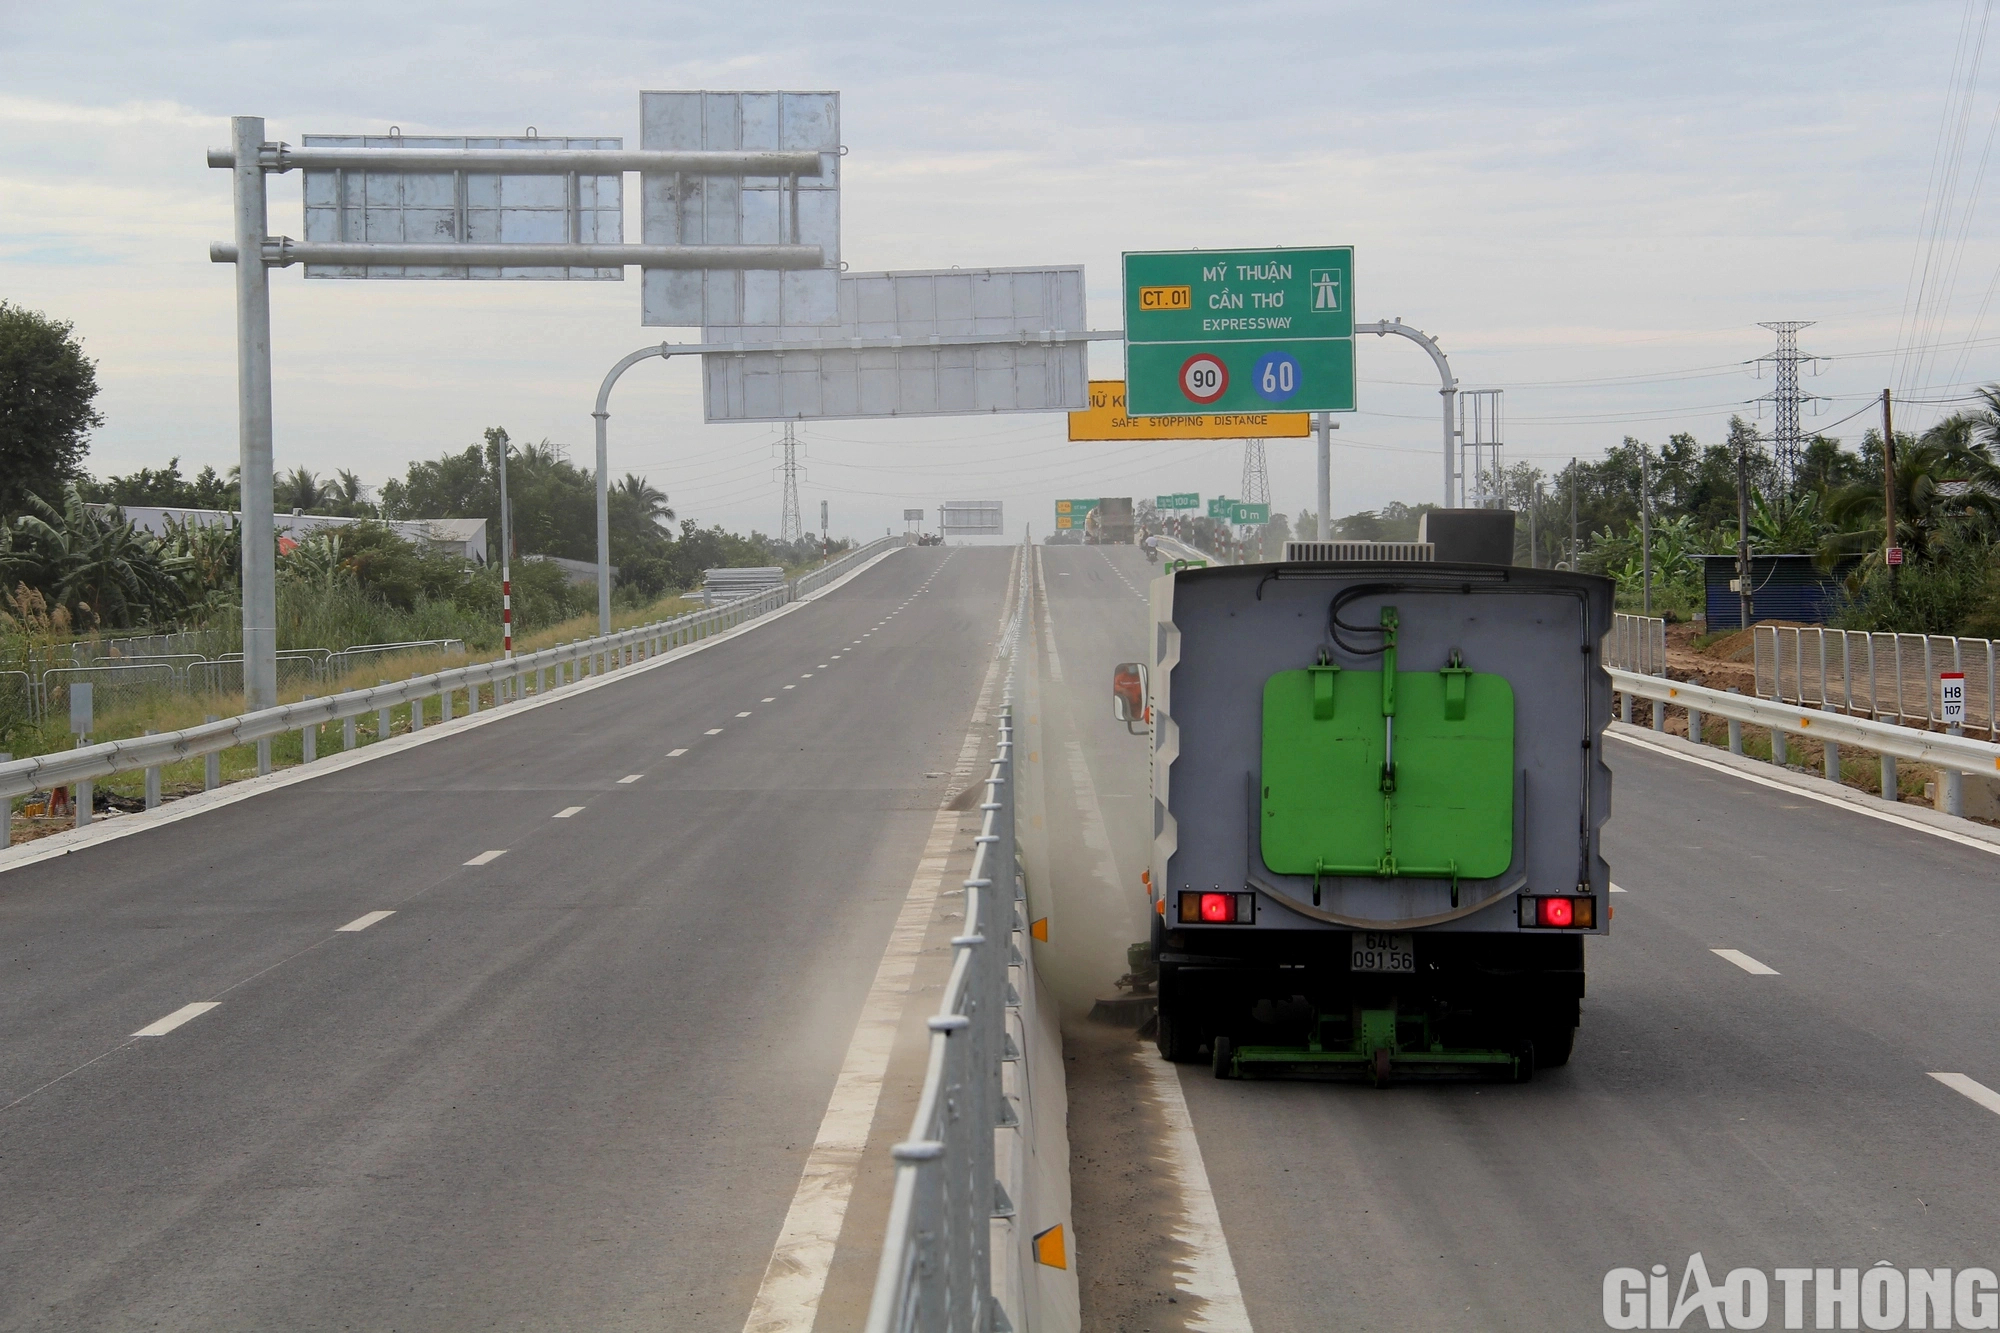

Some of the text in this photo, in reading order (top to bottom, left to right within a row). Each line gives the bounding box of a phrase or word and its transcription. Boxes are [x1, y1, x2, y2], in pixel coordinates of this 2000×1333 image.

[1203, 261, 1292, 284] MỸ THUẬN
[1143, 290, 1188, 306] CT.01
[1209, 287, 1284, 310] CẦN THƠ
[1203, 316, 1292, 331] EXPRESSWAY
[1193, 369, 1216, 388] 90
[1262, 361, 1293, 393] 60
[1089, 390, 1126, 408] IỮ K
[1111, 415, 1268, 428] SAFE STOPPING DISTANCE
[1175, 497, 1189, 506] 100
[1240, 509, 1247, 519] 0
[1944, 687, 1961, 698] H8
[1945, 706, 1961, 715] 107
[1366, 933, 1399, 950] 64C
